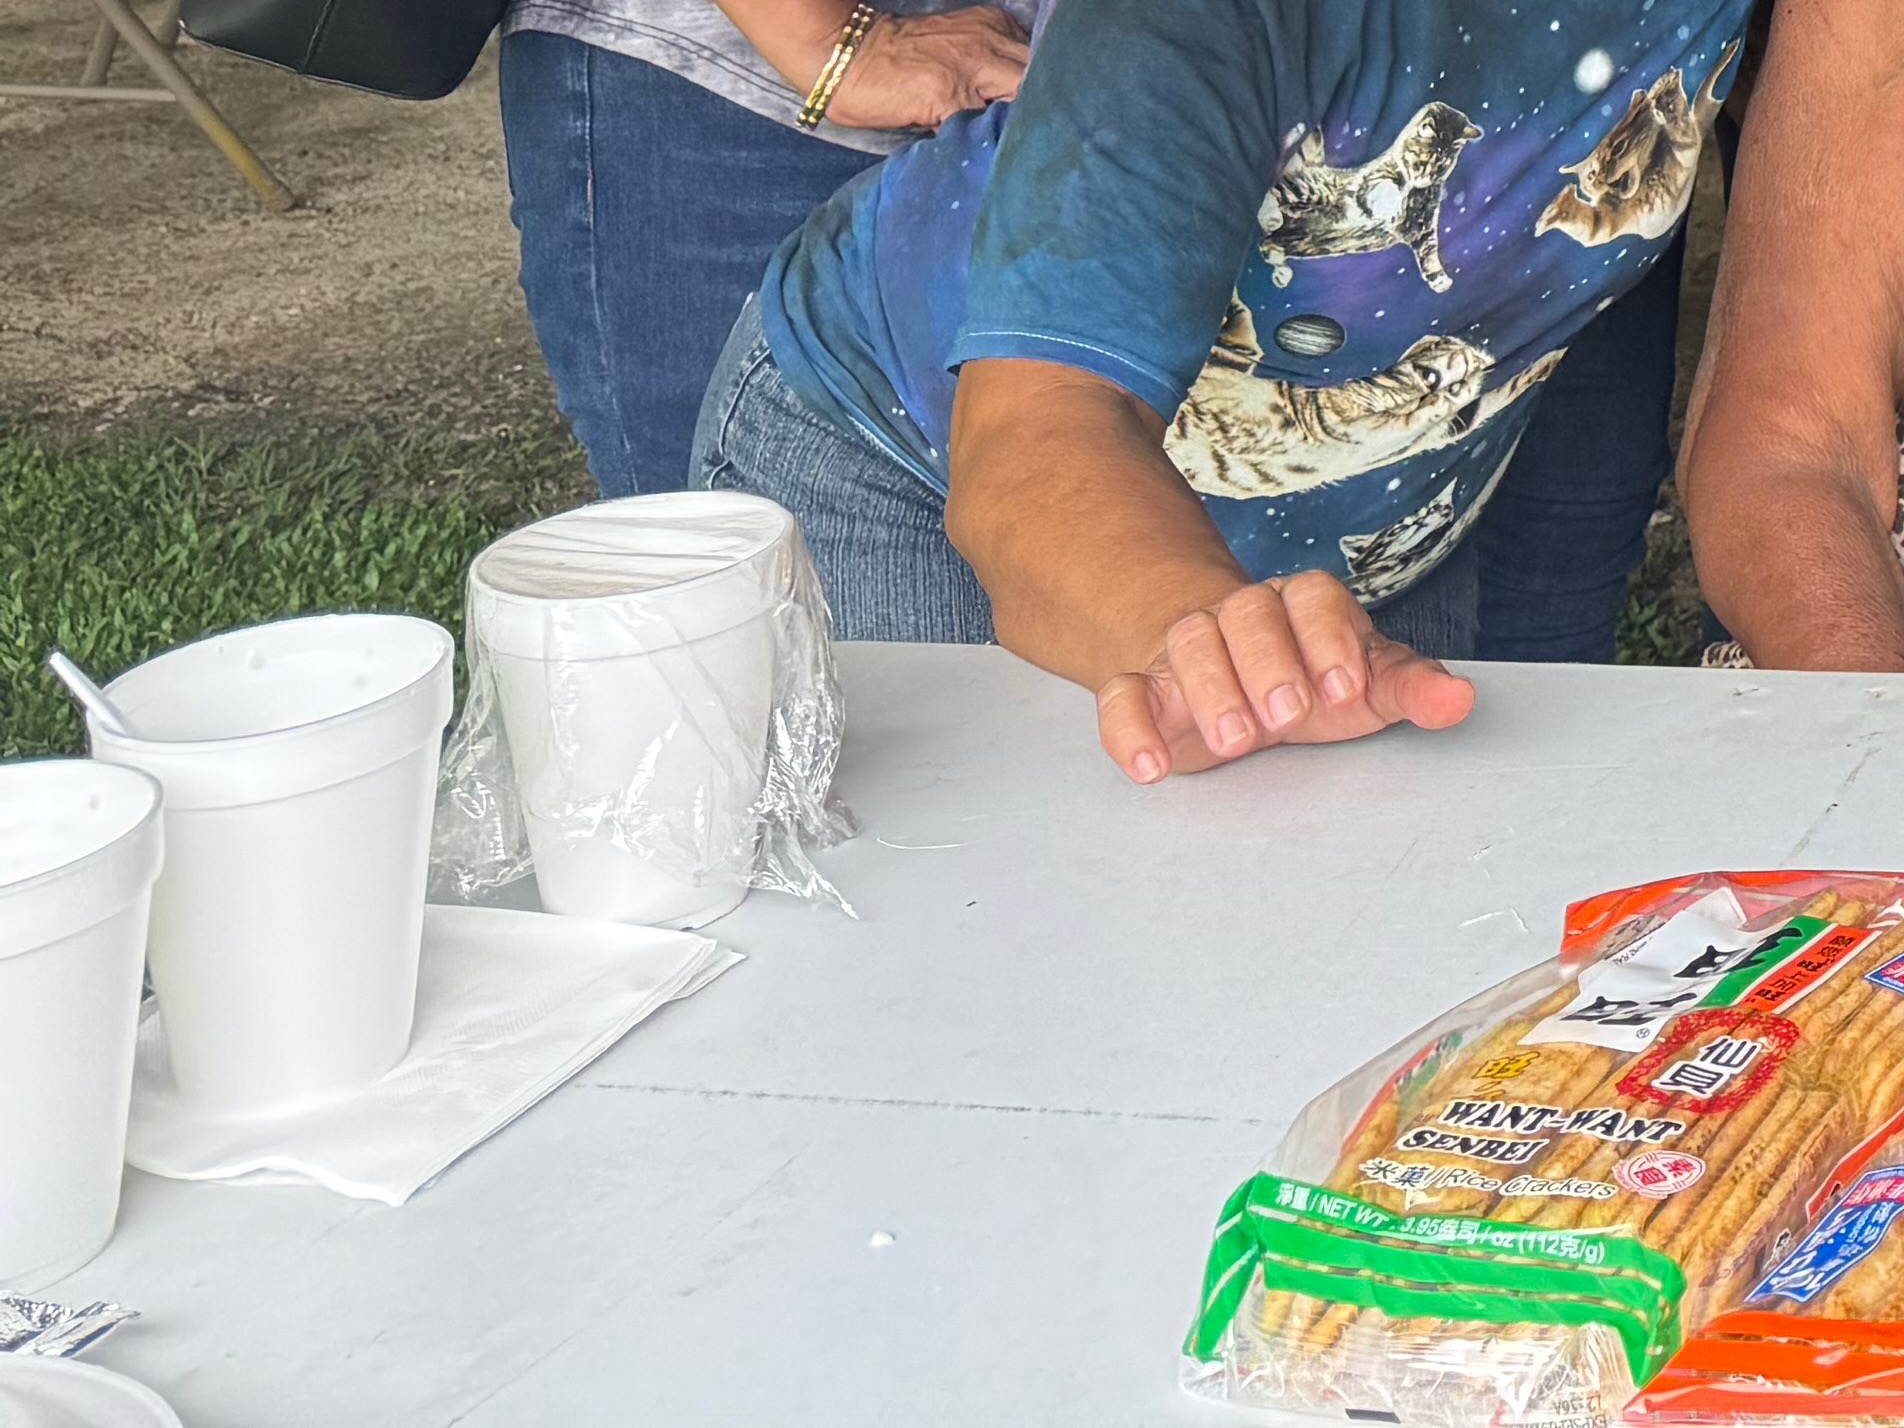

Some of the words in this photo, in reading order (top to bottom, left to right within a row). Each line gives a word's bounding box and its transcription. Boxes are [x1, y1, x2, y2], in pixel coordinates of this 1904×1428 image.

[1402, 1129, 1546, 1162] SENBEI
[1445, 1167, 1500, 1192] Rice
[1505, 1175, 1618, 1200] Crackers
[1319, 1194, 1352, 1221] NET
